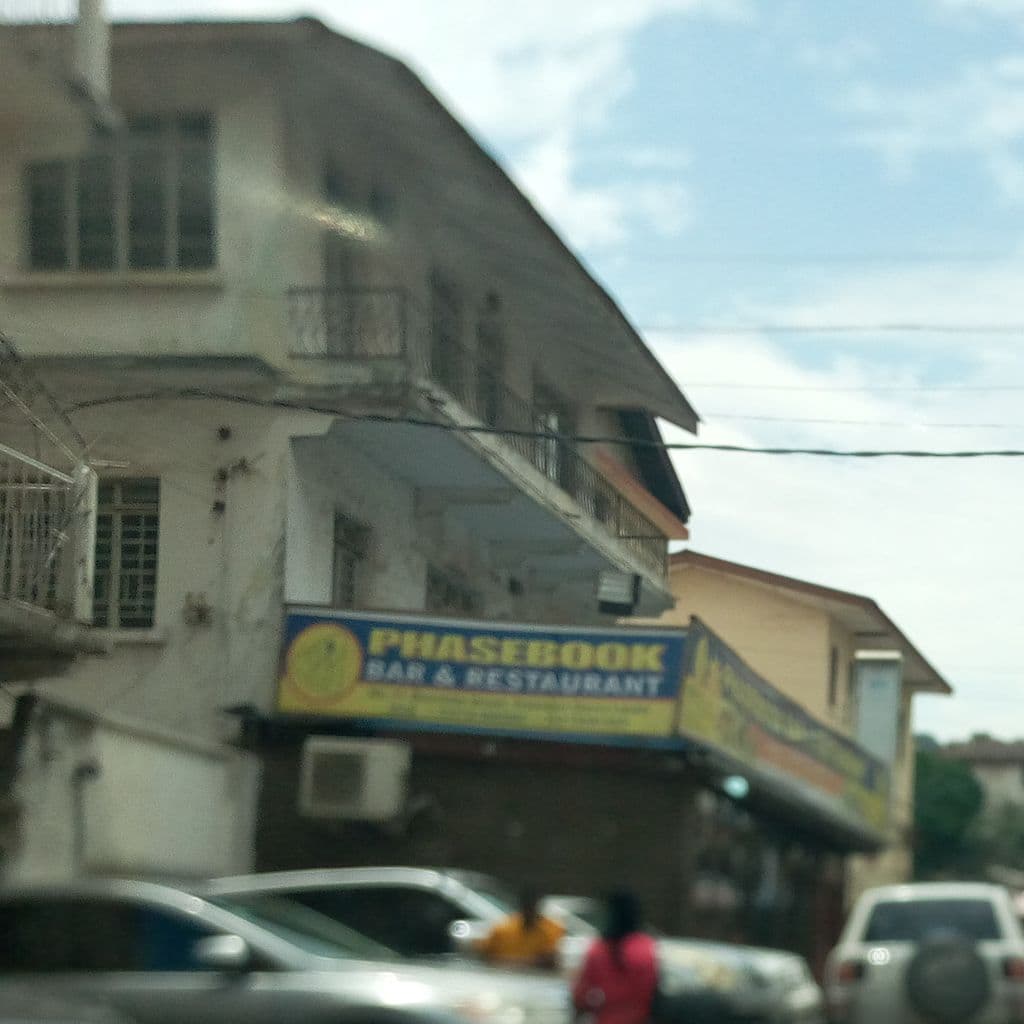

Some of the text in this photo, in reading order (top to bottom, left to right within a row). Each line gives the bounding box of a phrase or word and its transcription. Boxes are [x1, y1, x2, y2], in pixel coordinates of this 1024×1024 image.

[367, 627, 667, 671] PHASEBOOK
[364, 658, 664, 696] BAR & RESTAURANT
